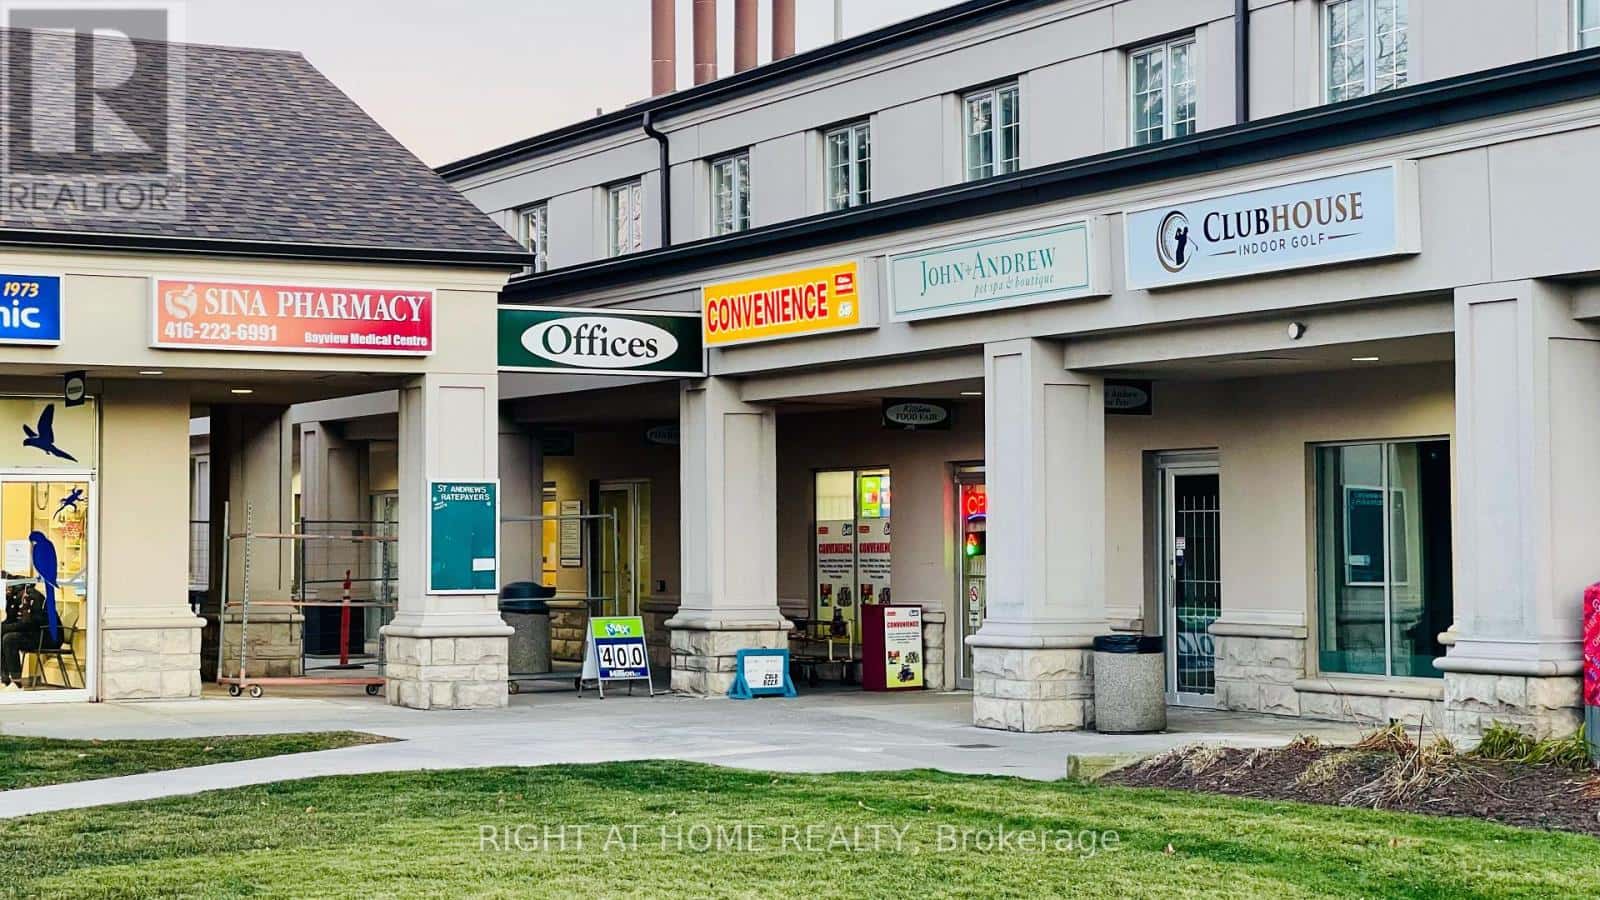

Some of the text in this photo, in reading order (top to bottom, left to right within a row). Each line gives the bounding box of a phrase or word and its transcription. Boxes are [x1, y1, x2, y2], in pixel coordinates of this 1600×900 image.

[1203, 192, 1364, 242] CLUBHOUSE
[1238, 234, 1326, 255] INDOOR GOLF
[3, 282, 39, 297] 1973
[204, 287, 425, 322] SINA PHARMACY
[707, 283, 828, 333] CONVENIENCE
[164, 321, 277, 342] 416-223-6991
[304, 331, 427, 346] Bayview Medical Centre
[542, 324, 659, 358] Offices
[437, 484, 487, 494] ST ANDREWS
[441, 493, 490, 501] RATEPAYERS
